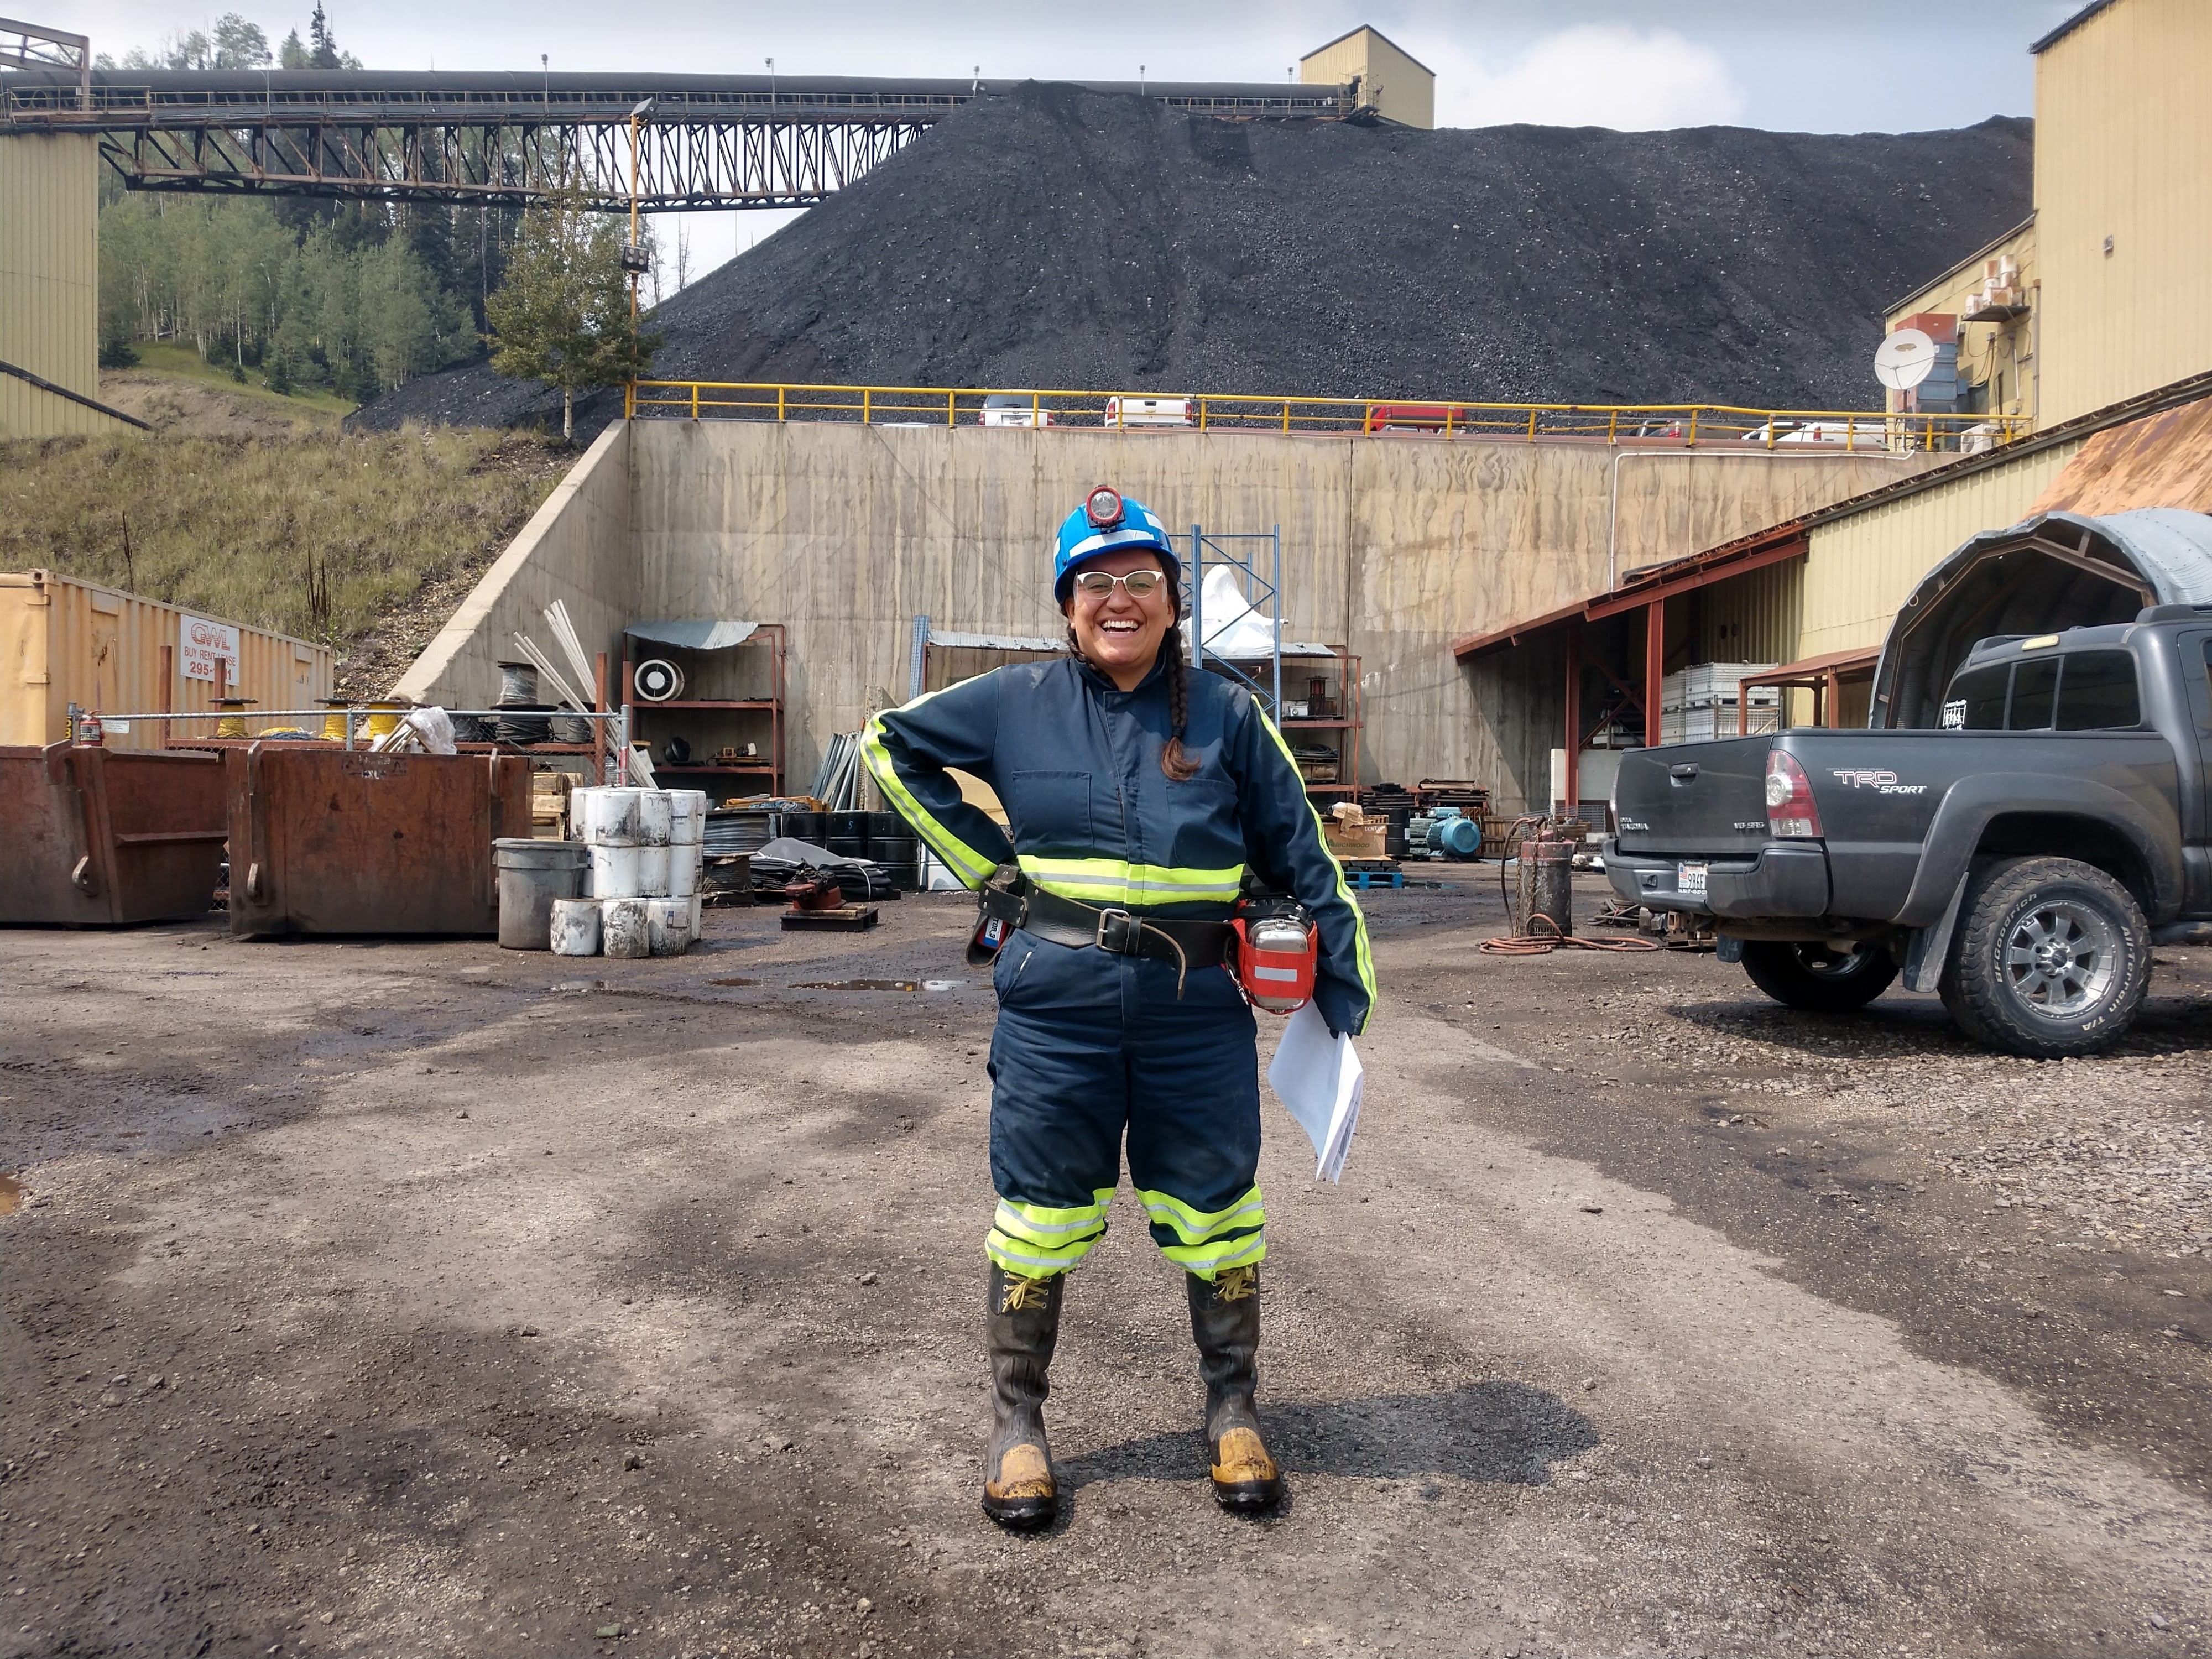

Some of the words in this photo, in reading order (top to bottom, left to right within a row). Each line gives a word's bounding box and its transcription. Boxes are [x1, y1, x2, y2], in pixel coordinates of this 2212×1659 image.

[191, 623, 230, 651] GWL
[184, 646, 197, 658] BUY
[200, 649, 216, 661] RENT
[1834, 771, 1897, 788] TRD
[1880, 786, 1927, 794] SPORT
[848, 820, 854, 830] 5
[1994, 893, 2037, 983] BFGoodrich
[2081, 1016, 2106, 1031] T/A
